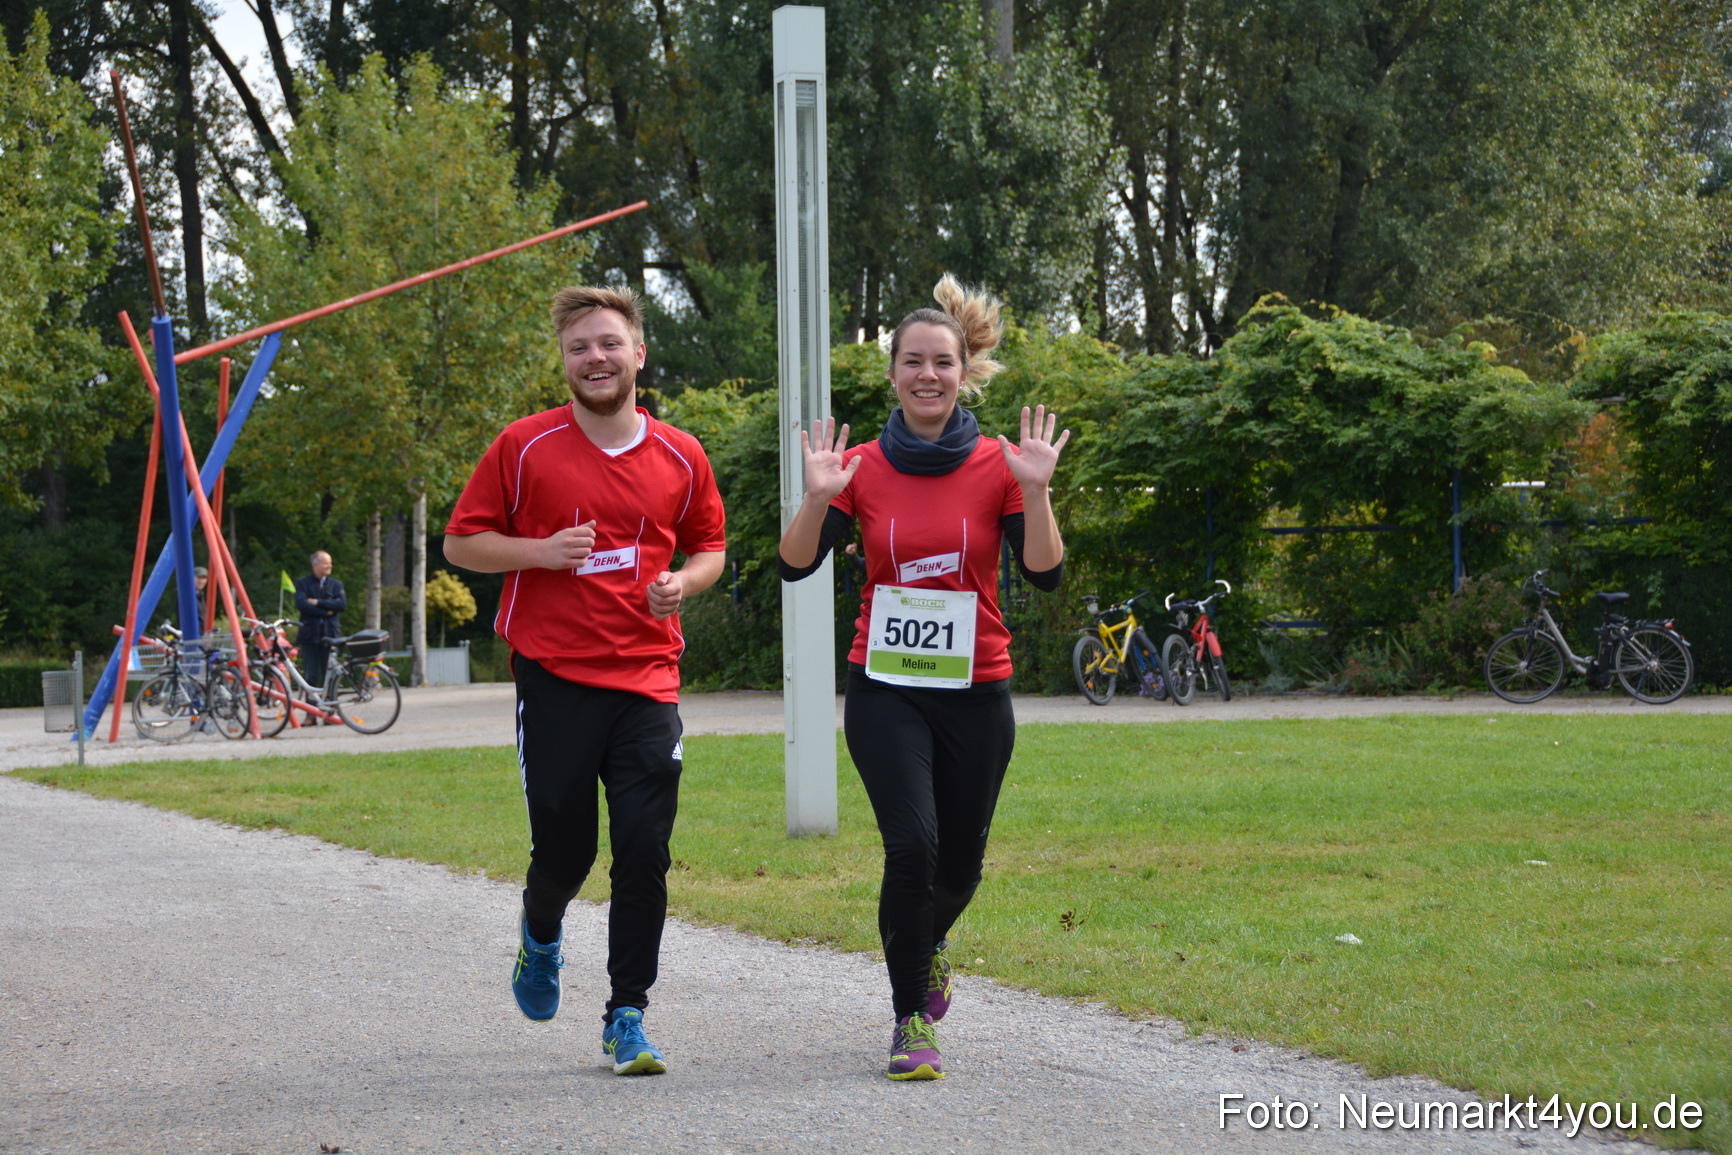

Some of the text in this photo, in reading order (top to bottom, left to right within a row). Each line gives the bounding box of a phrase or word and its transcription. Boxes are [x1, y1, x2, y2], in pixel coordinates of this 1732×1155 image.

[593, 555, 621, 567] DEHN
[916, 561, 943, 573] DEHN
[910, 597, 946, 608] BOCK
[884, 617, 954, 650] 5021
[901, 657, 937, 671] Melina
